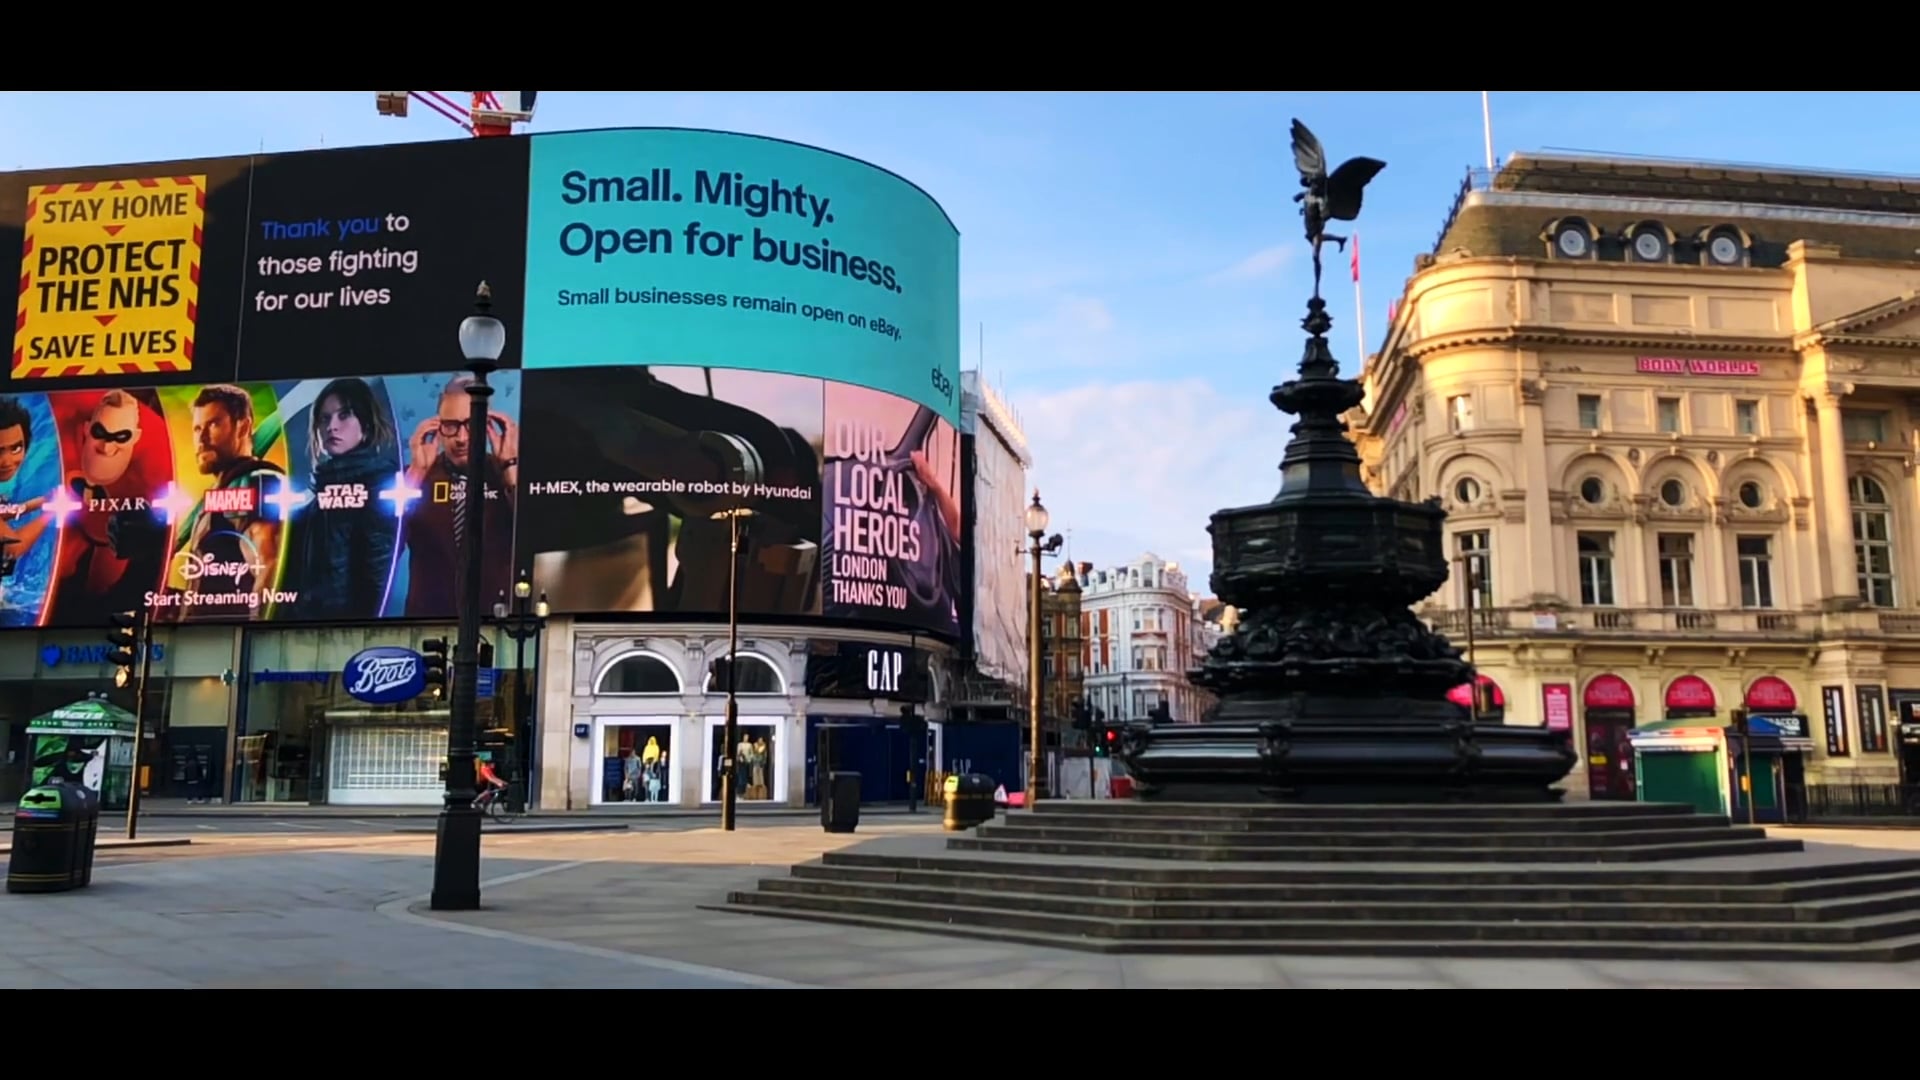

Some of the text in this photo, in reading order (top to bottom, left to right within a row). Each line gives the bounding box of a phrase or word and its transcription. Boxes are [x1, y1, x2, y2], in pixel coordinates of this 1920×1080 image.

[43, 192, 188, 224] STAY HOME
[561, 168, 834, 228] Small. Mighty.
[261, 214, 410, 241] Thank you to
[38, 239, 186, 277] PROTECT
[258, 248, 419, 276] those fighting
[559, 221, 903, 295] Open for business.
[37, 275, 180, 313] THE NHS
[255, 286, 391, 312] for our lives
[557, 286, 903, 342] Small businesses remain open on eBay.
[30, 329, 177, 360] SAVE LIVES
[1638, 357, 1761, 375] BODY WORLDS
[931, 363, 954, 407] ebay
[834, 420, 887, 465] OUR
[88, 497, 147, 512] PIXAR
[204, 488, 254, 511] MARVEL
[317, 495, 366, 510] WARS
[324, 484, 370, 497] STAR
[529, 479, 812, 501] H-MEX, the wearable robot by Hyundai
[834, 464, 909, 515] LOCAL
[833, 512, 921, 562] HEROES
[833, 556, 887, 580] LONDON
[144, 588, 298, 608] Start Streaming Now
[832, 580, 907, 610] THANKS YOU
[350, 656, 416, 693] Boots
[867, 650, 902, 692] GAP
